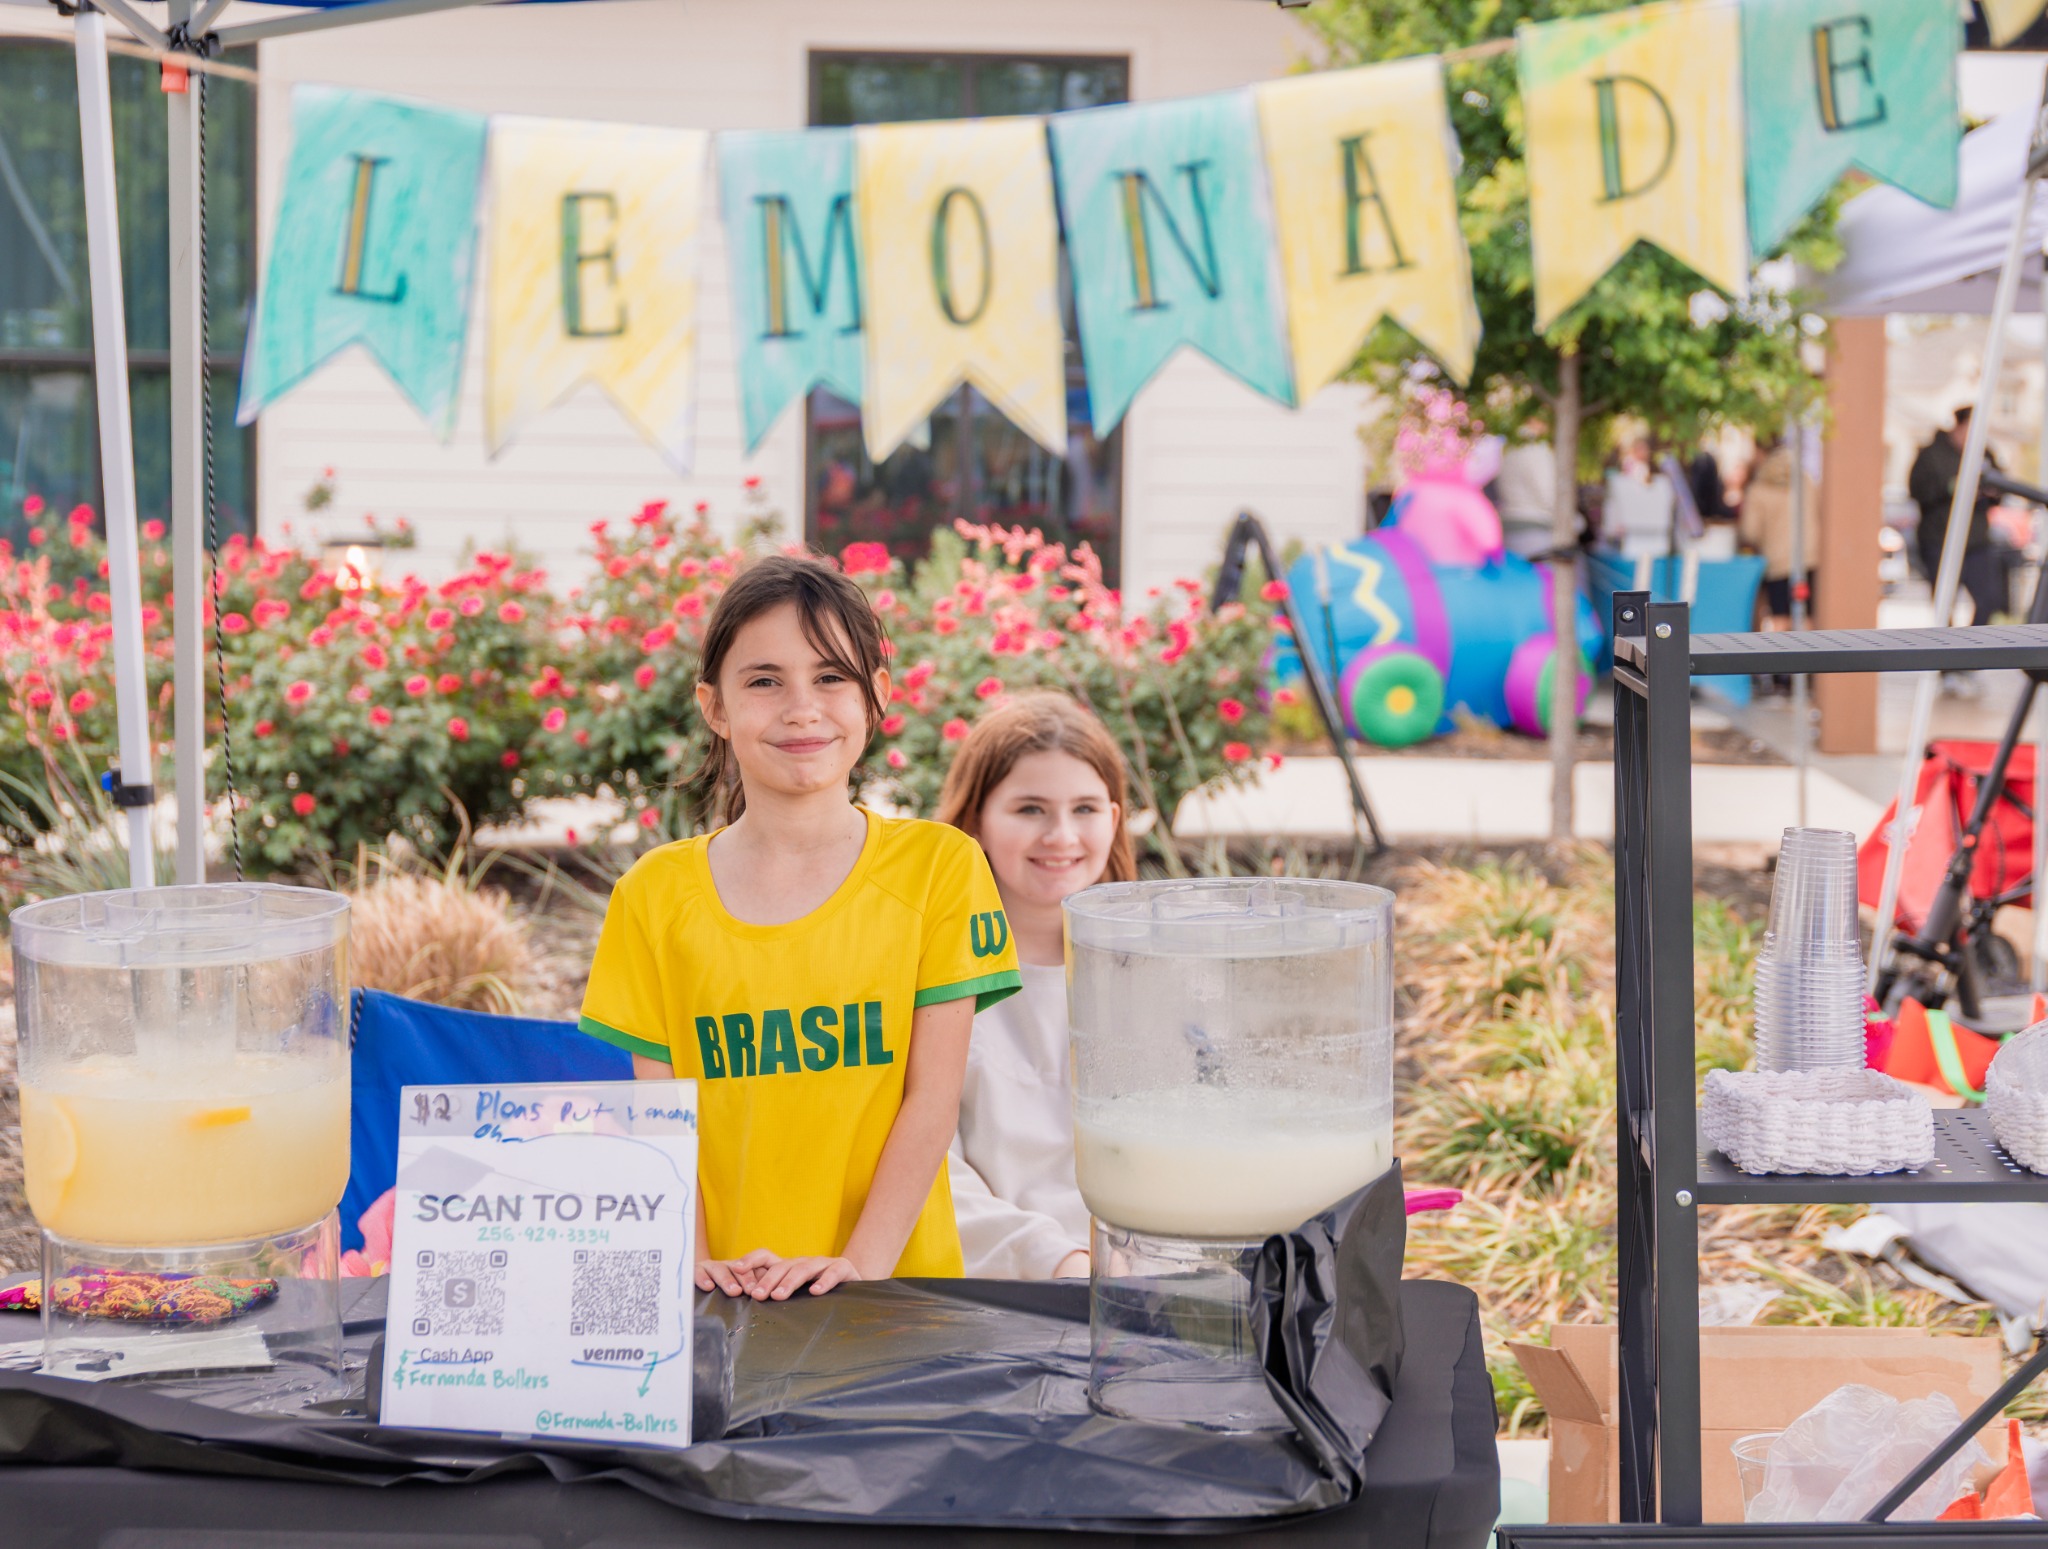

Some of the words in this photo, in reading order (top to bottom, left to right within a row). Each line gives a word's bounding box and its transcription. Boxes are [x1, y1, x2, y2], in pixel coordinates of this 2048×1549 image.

[332, 14, 1889, 346] LEMONADE
[694, 1000, 895, 1080] BRASIL
[417, 1194, 522, 1222] SCAN
[532, 1194, 583, 1222] TO
[595, 1194, 666, 1222] PAY
[420, 1347, 459, 1363] Cash
[461, 1348, 494, 1364] App
[582, 1348, 645, 1361] venmo
